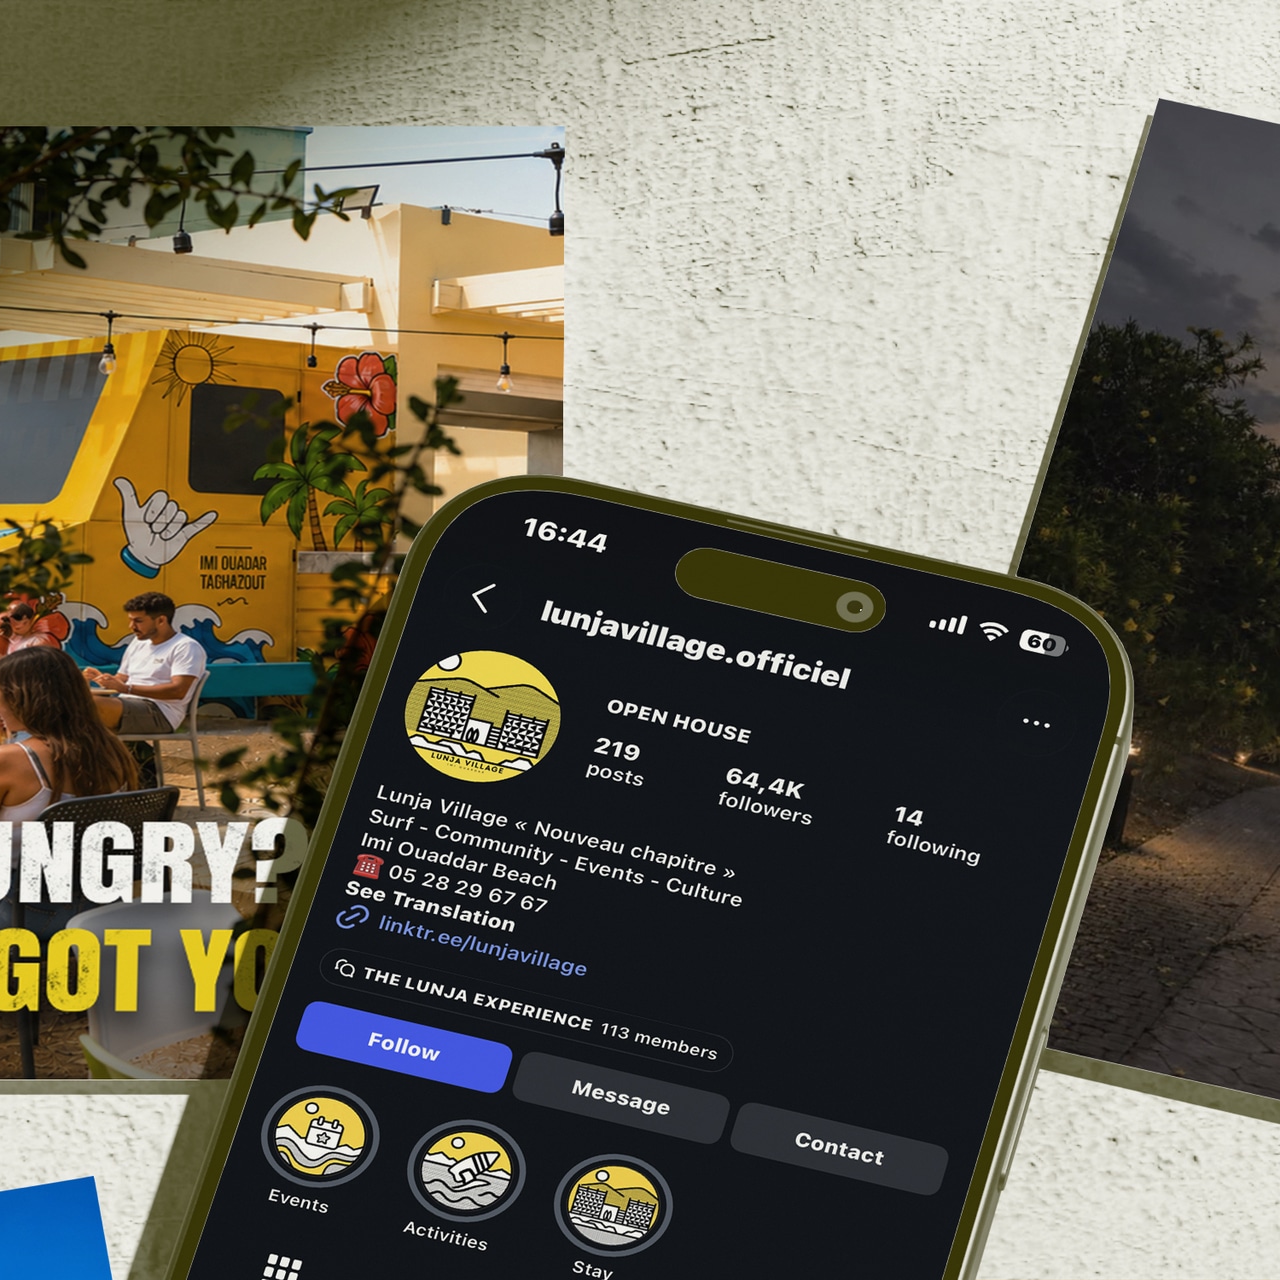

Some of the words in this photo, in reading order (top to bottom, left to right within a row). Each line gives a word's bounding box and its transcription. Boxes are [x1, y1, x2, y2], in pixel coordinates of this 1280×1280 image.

[524, 518, 607, 553] 16:44
[199, 555, 218, 572] IMI
[221, 555, 267, 572] OUADAR
[200, 573, 267, 591] TAGHAZOUT
[540, 600, 851, 689] lunjavillage.officiel
[1027, 634, 1059, 654] 60
[607, 699, 668, 724] OPEN
[672, 714, 751, 743] HOUSE
[431, 752, 461, 765] LUNJA
[465, 760, 504, 775] VILLAGE
[593, 737, 640, 761] 219
[585, 764, 643, 786] posts
[726, 767, 804, 799] 64,4K
[718, 791, 812, 825] followers
[895, 806, 923, 826] 14
[376, 785, 431, 810] Lunja
[441, 798, 507, 827] Village
[534, 821, 624, 854] Nouveau
[630, 845, 716, 875] chapitre
[361, 832, 393, 852] Imi
[398, 841, 488, 873] Ouaddar
[492, 862, 556, 890] Beach
[369, 809, 415, 830] Surf
[435, 824, 553, 865] Community
[574, 856, 644, 884] Events
[666, 877, 742, 907] Culture
[886, 830, 980, 866] following
[389, 865, 416, 883] 05
[421, 872, 449, 890] 28
[454, 880, 482, 898] 29
[488, 888, 516, 904] 67
[520, 895, 548, 912] 67
[345, 880, 385, 901] See
[393, 890, 515, 932] Translation
[379, 915, 586, 976] linktr.ee/lunjavillage
[180, 928, 282, 1012] YO
[364, 967, 401, 986] THE
[404, 977, 466, 1002] LUNJA
[473, 993, 593, 1031] EXPERIENCE
[601, 1023, 629, 1039] 113
[634, 1032, 717, 1060] members
[367, 1032, 440, 1061] Follow
[571, 1080, 670, 1115] Message
[795, 1132, 884, 1165] Contact
[268, 1188, 328, 1213] Events
[403, 1221, 487, 1251] Activities
